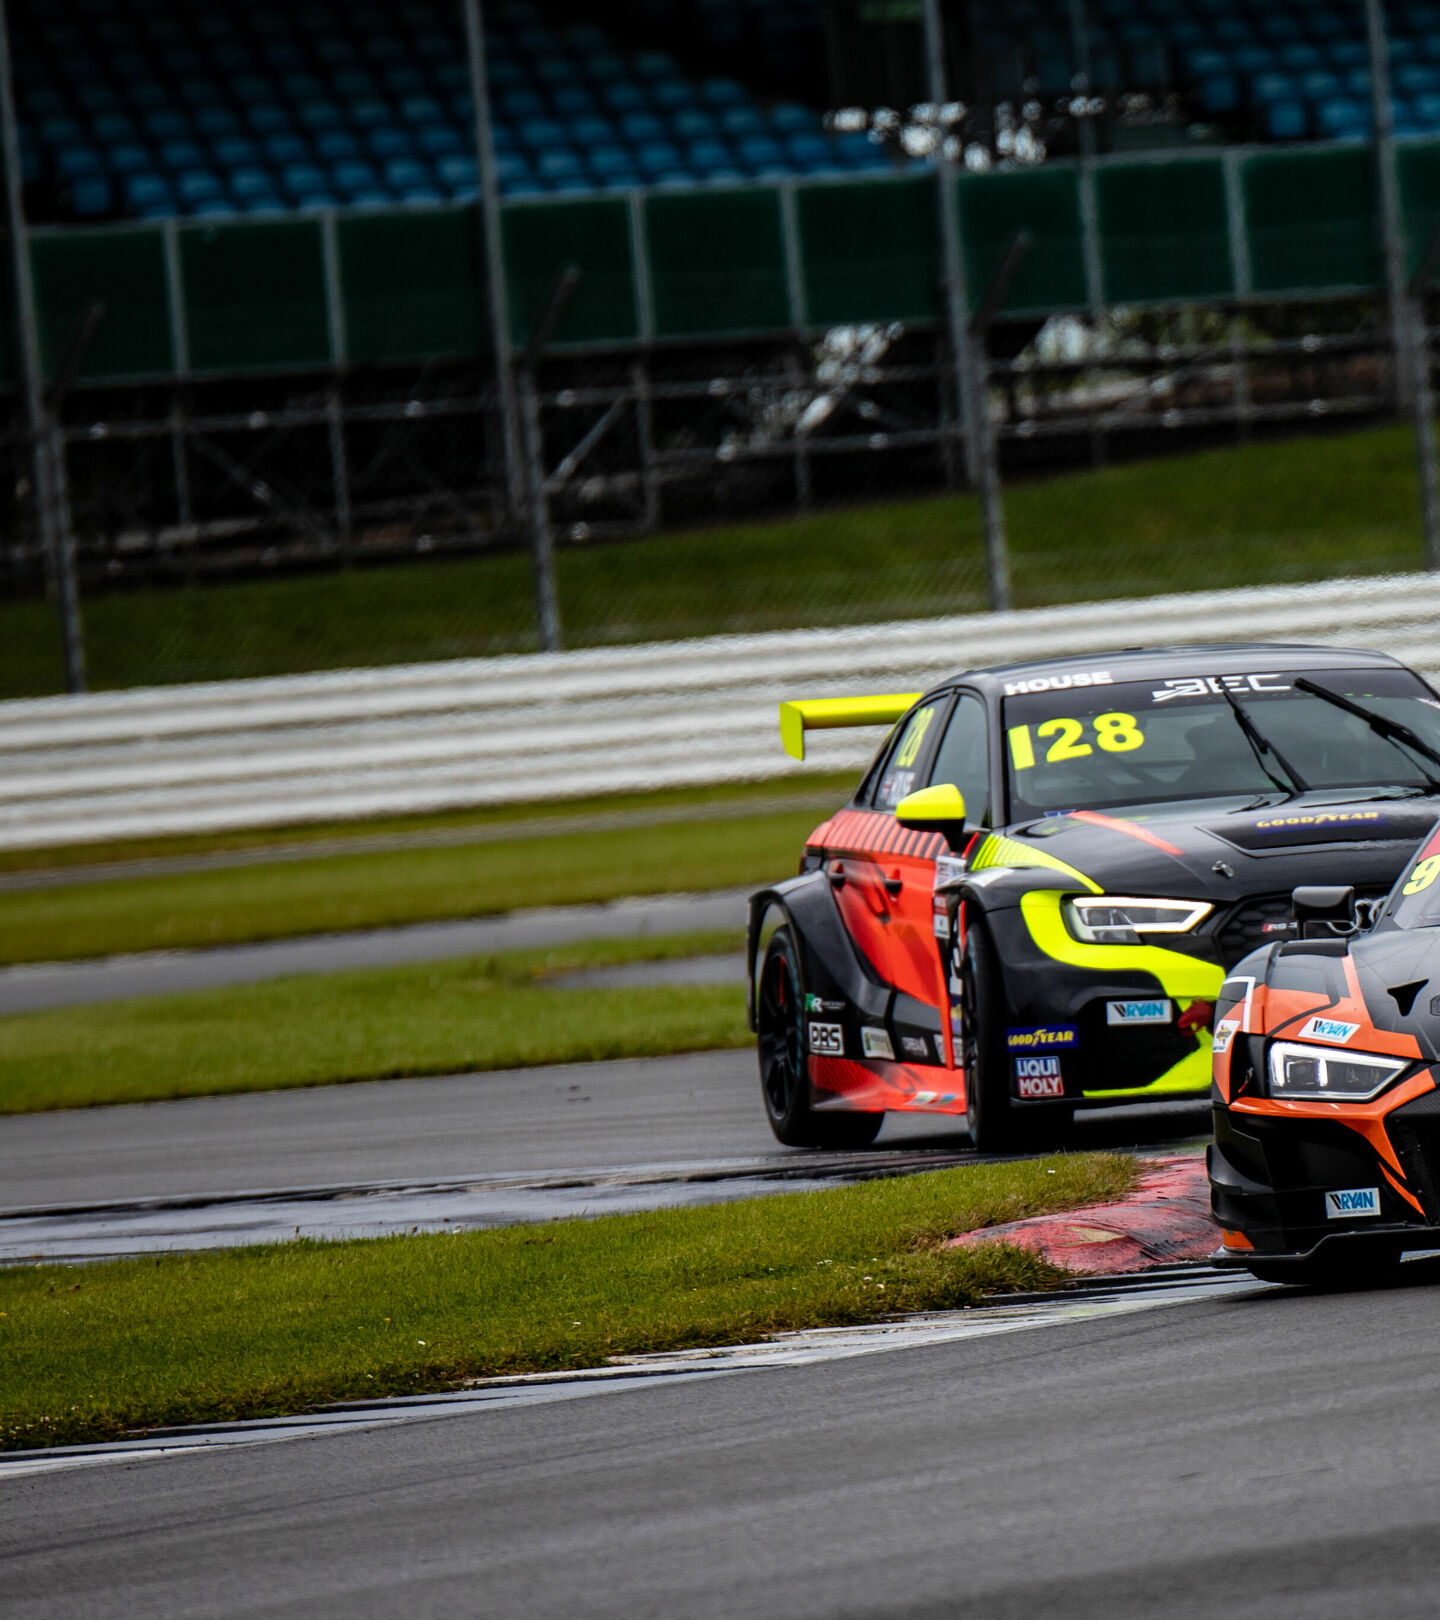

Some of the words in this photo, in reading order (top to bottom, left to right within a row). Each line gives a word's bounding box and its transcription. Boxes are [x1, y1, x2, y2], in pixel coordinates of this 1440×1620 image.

[1004, 671, 1113, 696] HOUSE
[1008, 712, 1145, 771] 128
[1256, 812, 1379, 828] GOODYEAR
[1126, 1003, 1165, 1017] RYAN
[1008, 1029, 1074, 1046] GOODYEAR
[1017, 1058, 1058, 1076] LIQUI
[1020, 1076, 1061, 1095] MOLY
[1341, 1191, 1375, 1210] RYAN
